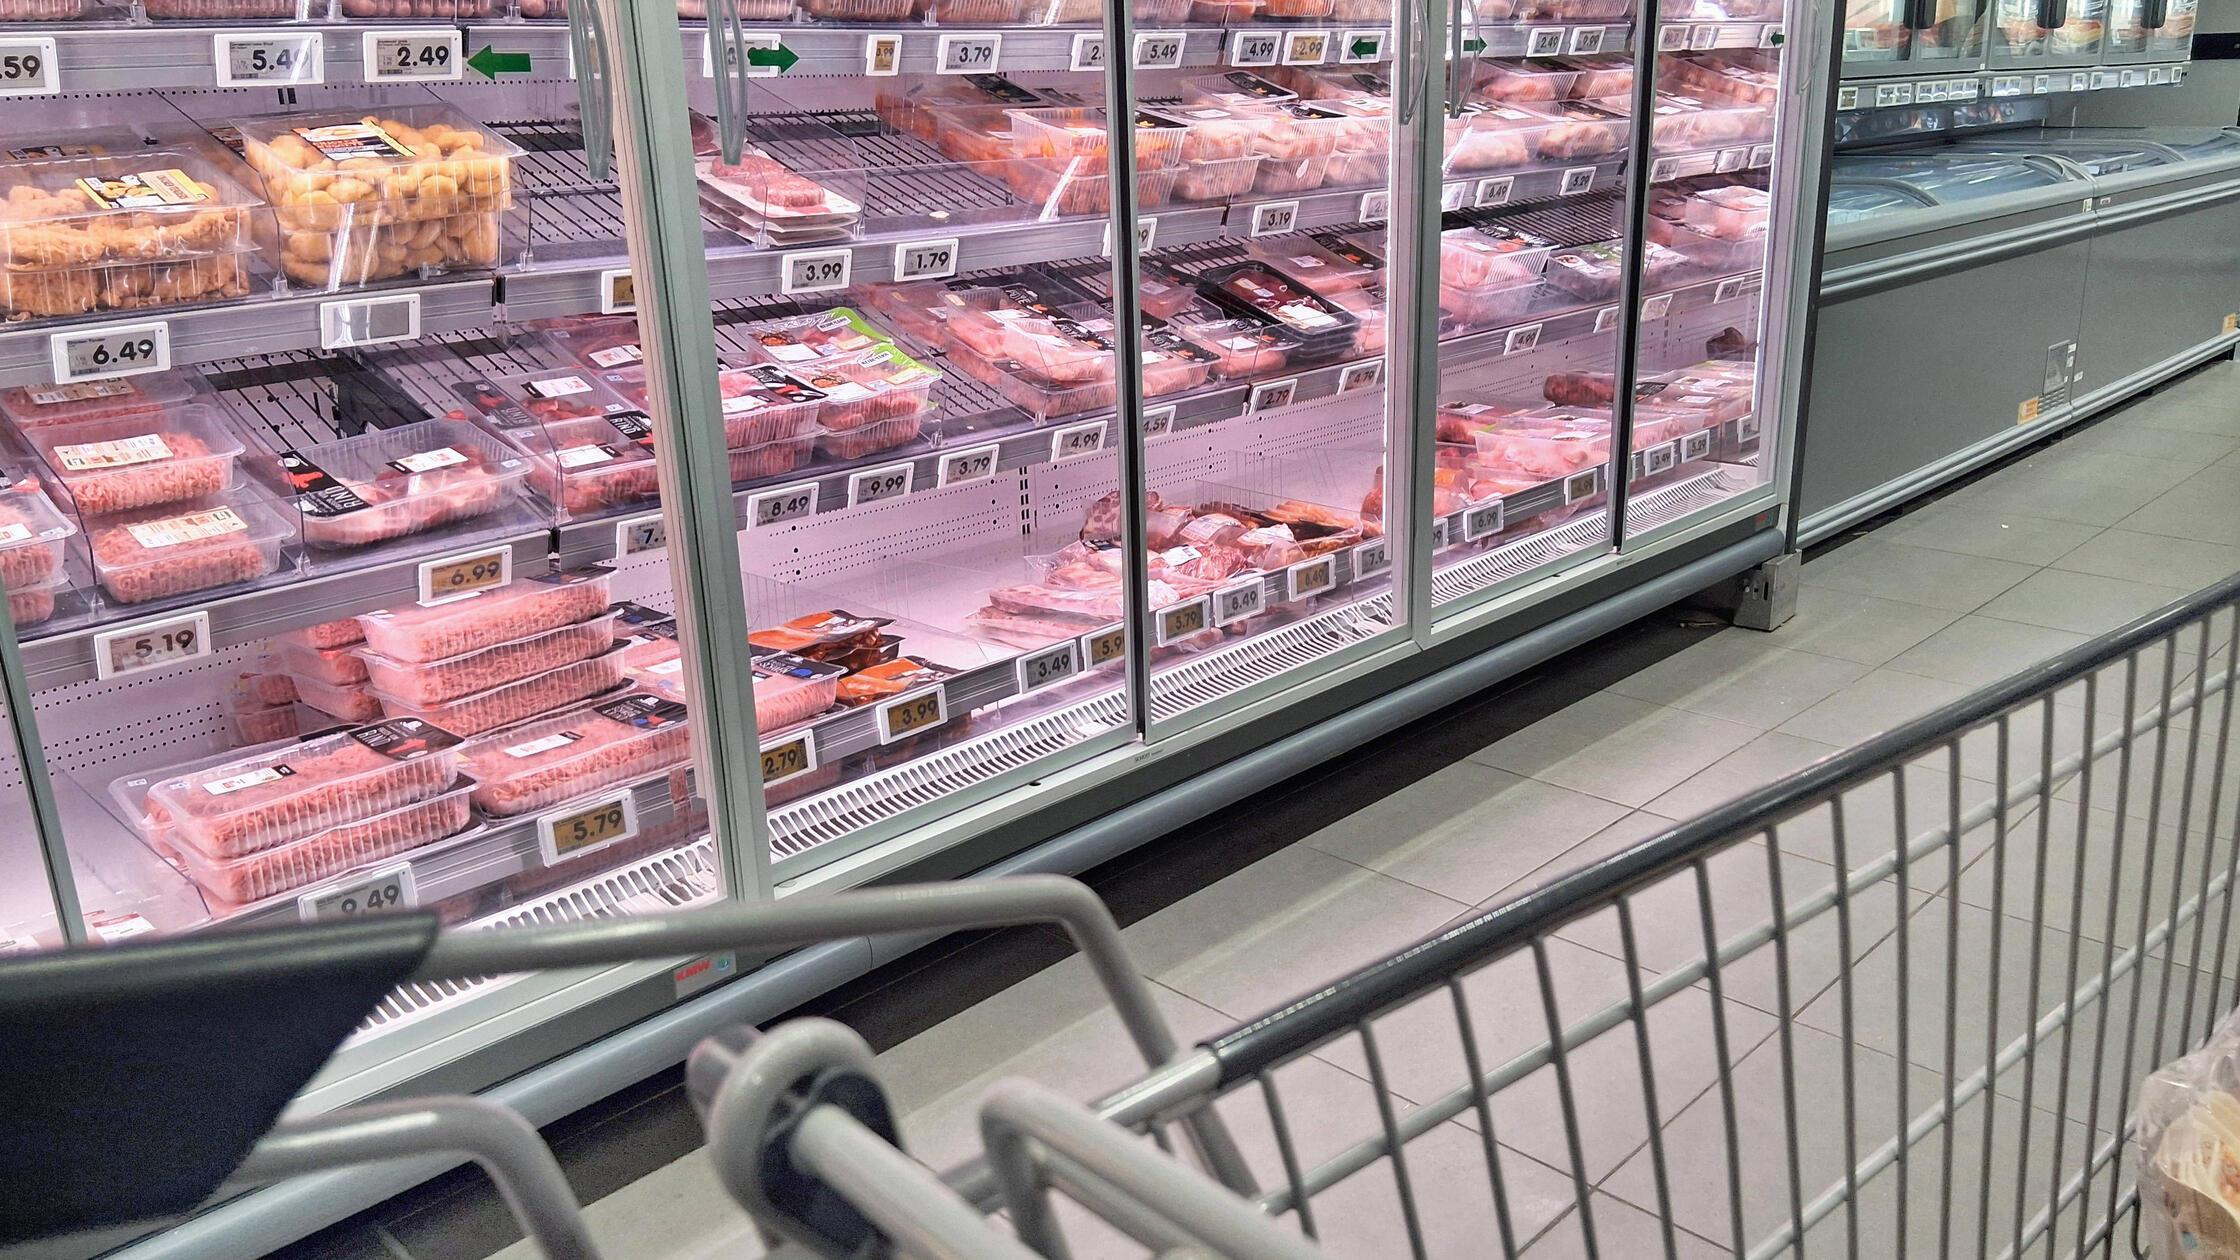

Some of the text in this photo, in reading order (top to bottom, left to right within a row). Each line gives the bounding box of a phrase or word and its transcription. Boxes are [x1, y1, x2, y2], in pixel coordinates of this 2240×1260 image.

[397, 46, 449, 66] 2.49
[959, 47, 992, 62] 3.79
[1150, 44, 1177, 59] 5.49
[1249, 42, 1274, 56] 4.99
[1299, 42, 1322, 55] 2.99
[0, 55, 41, 79] .59
[1268, 212, 1290, 226] 3.19
[917, 251, 949, 269] 1.79
[806, 262, 842, 281] 3.99
[92, 339, 154, 365] 6.49
[1267, 390, 1289, 404] 2.79
[1071, 432, 1099, 448] 4.99
[959, 457, 990, 475] 3.79
[871, 476, 904, 495] 9.99
[771, 496, 809, 517] 8.49
[1369, 551, 1384, 566] 7.9
[451, 561, 500, 586] 6.99
[135, 629, 195, 658] 5.19
[1101, 636, 1123, 656] 5.9
[1038, 654, 1069, 678] 3.49
[902, 699, 938, 725] 3.99
[764, 748, 797, 775] 2.79
[573, 809, 622, 841] 5.79
